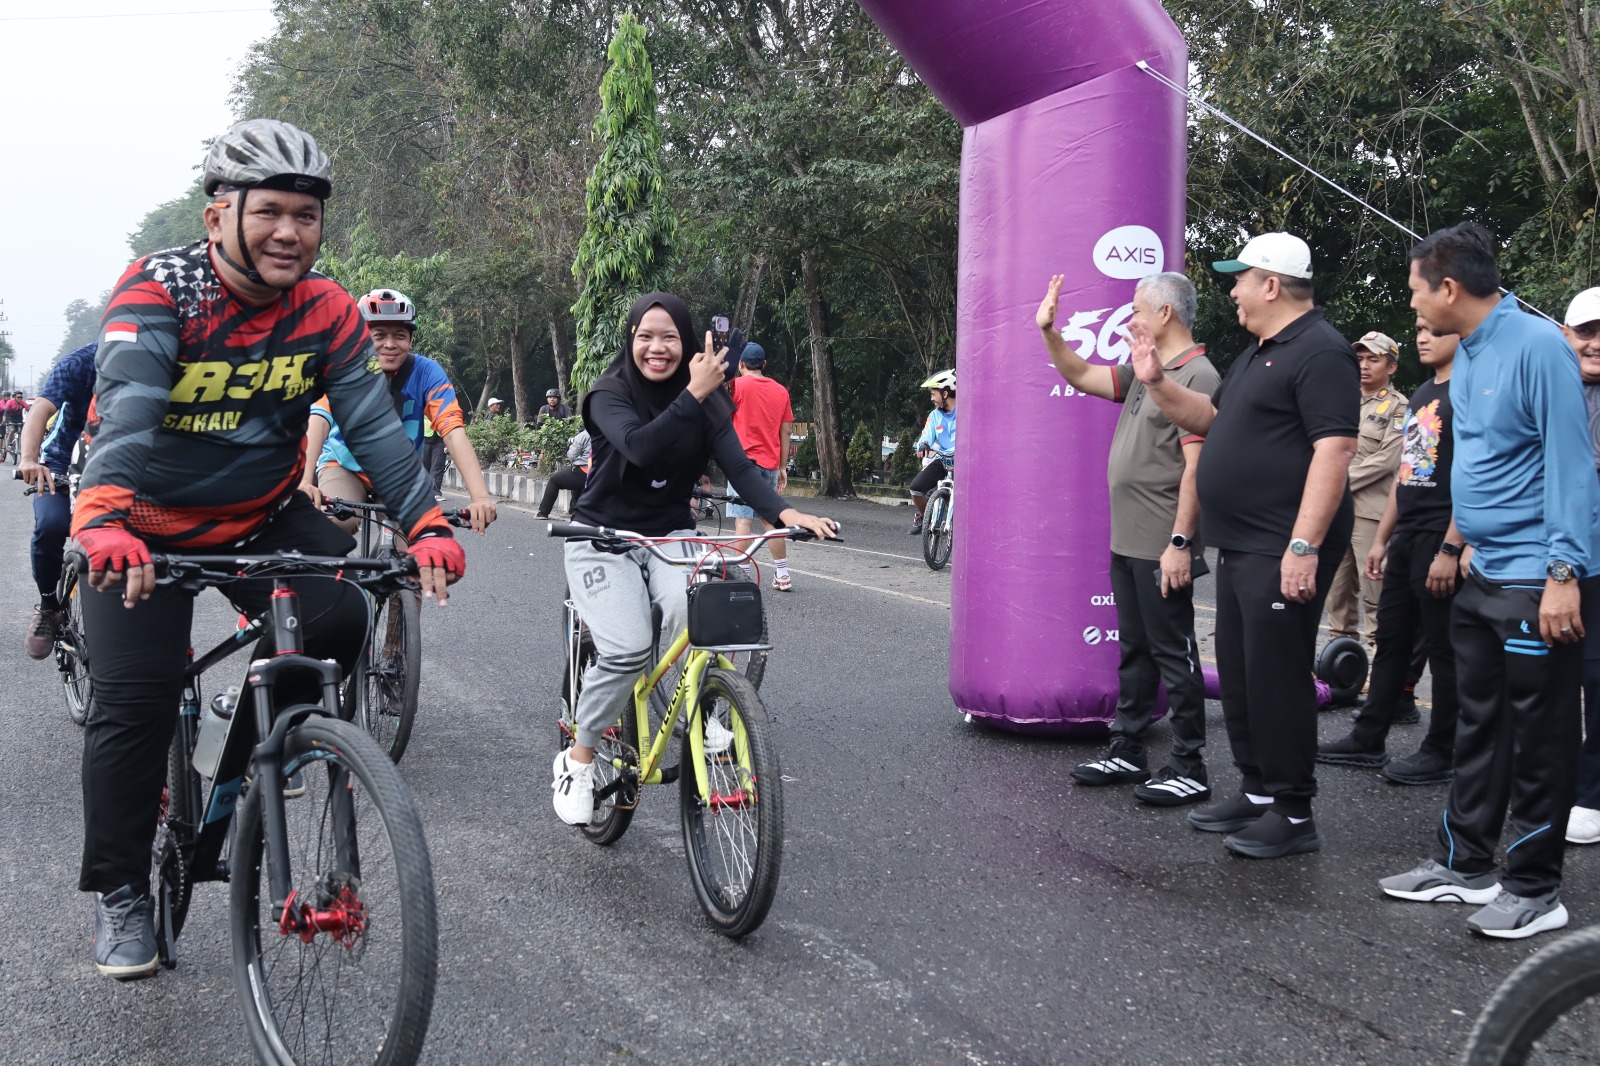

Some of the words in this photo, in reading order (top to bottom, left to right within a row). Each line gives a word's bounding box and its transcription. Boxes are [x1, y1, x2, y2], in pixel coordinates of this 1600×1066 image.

[1105, 245, 1156, 265] AXIS
[583, 565, 606, 589] 03
[1090, 592, 1117, 606] axi
